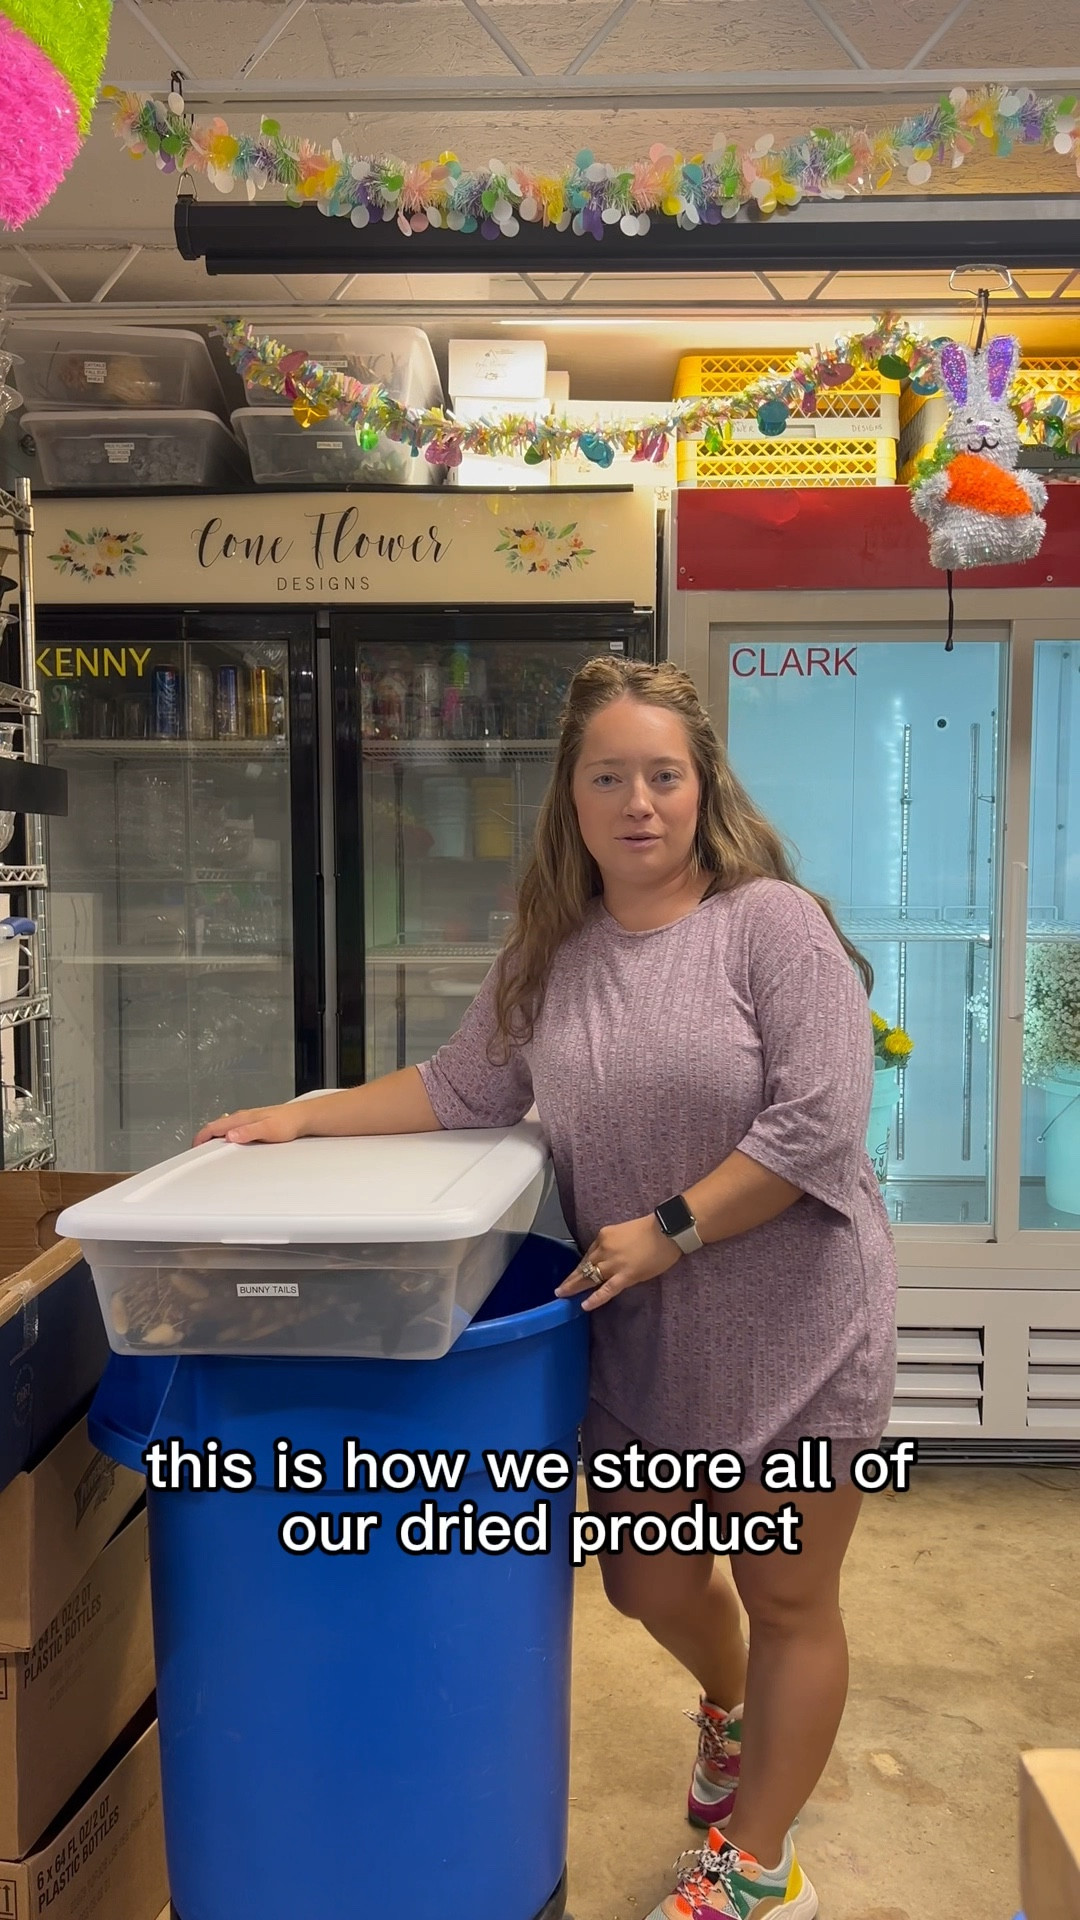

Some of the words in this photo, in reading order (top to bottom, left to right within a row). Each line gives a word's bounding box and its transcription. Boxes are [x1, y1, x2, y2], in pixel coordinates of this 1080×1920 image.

[191, 517, 294, 568] Cone
[304, 506, 453, 570] Flower
[277, 576, 370, 591] DESIGNS
[35, 647, 151, 677] KENNY
[732, 647, 858, 677] CLARK
[240, 1286, 270, 1294] BUNNY
[272, 1285, 297, 1294] TAILS
[24, 1634, 63, 1690] PLASTIC
[65, 1594, 102, 1647] BOTTLES
[37, 1870, 44, 1891] 6
[55, 1847, 66, 1874] 64
[68, 1839, 78, 1860] FL
[79, 1809, 98, 1845] OZ/2
[38, 1855, 80, 1914] PLASTIC
[83, 1805, 120, 1865] BOTTLES
